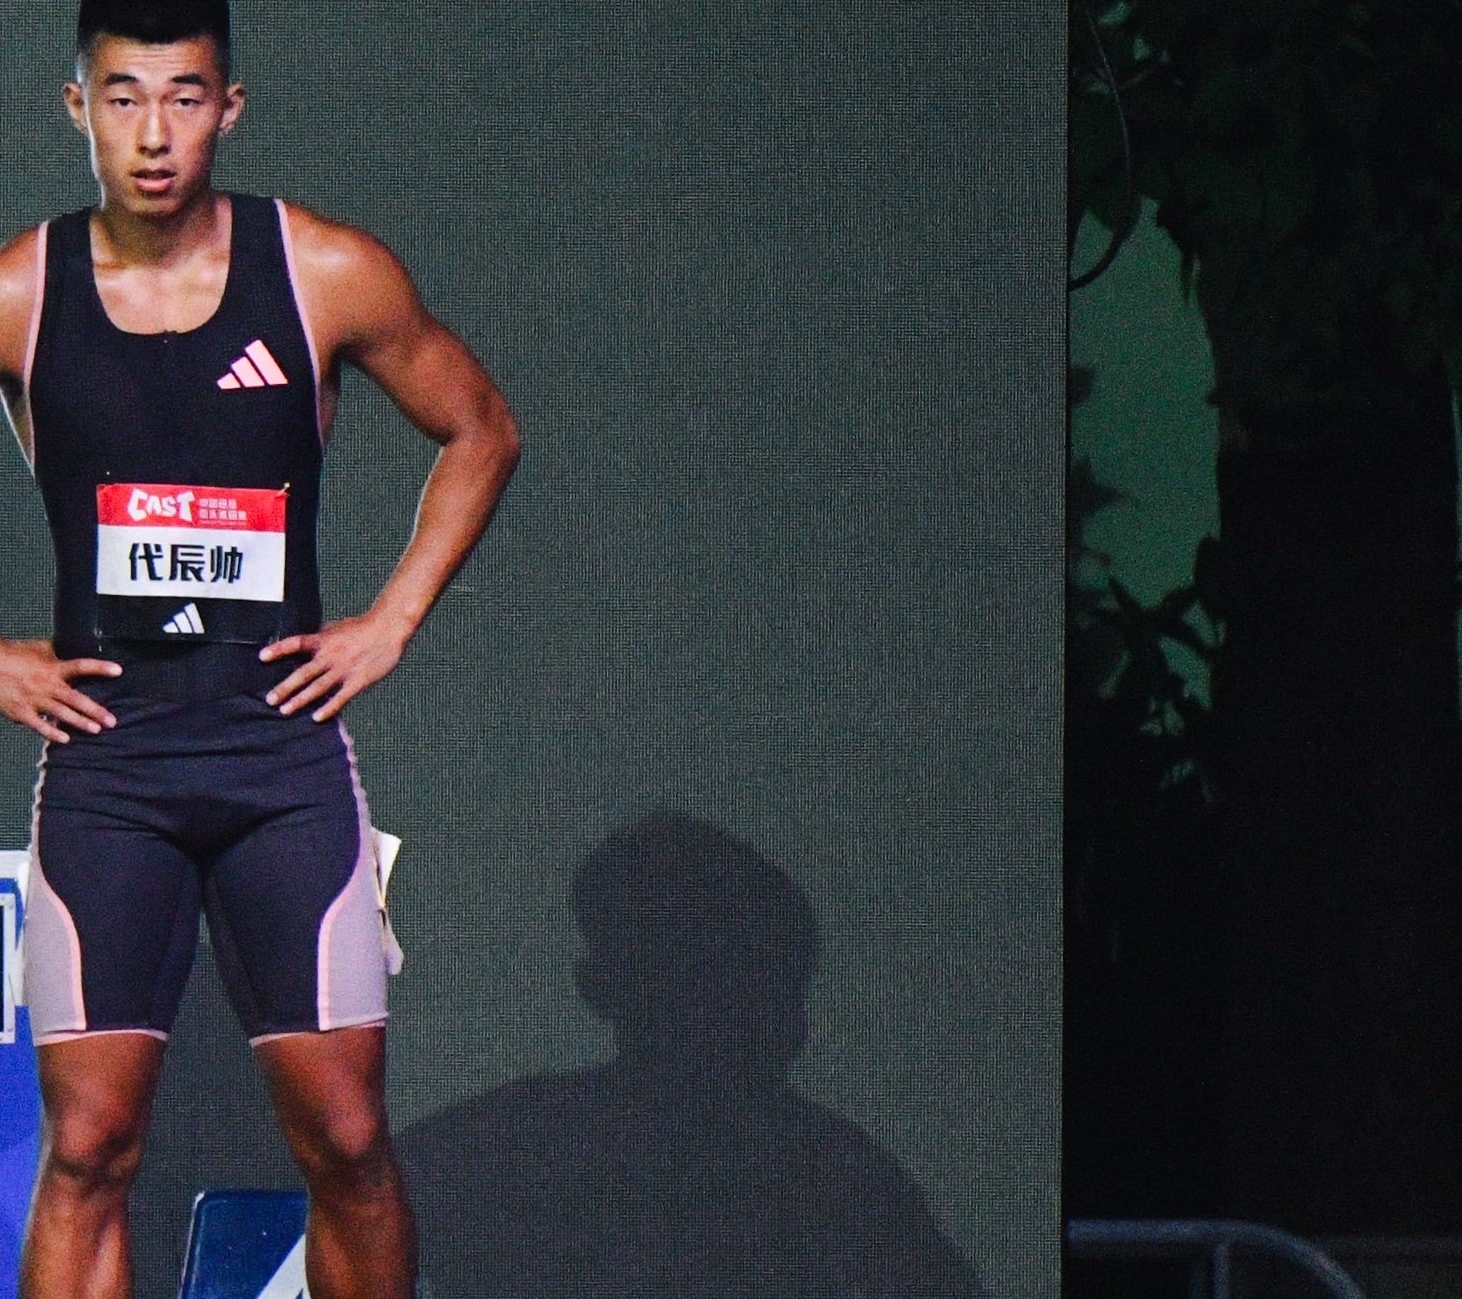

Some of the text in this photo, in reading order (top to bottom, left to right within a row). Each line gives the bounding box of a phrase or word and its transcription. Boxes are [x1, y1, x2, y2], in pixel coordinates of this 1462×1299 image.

[127, 488, 195, 522] CAST
[128, 543, 243, 583] 代辰帅
